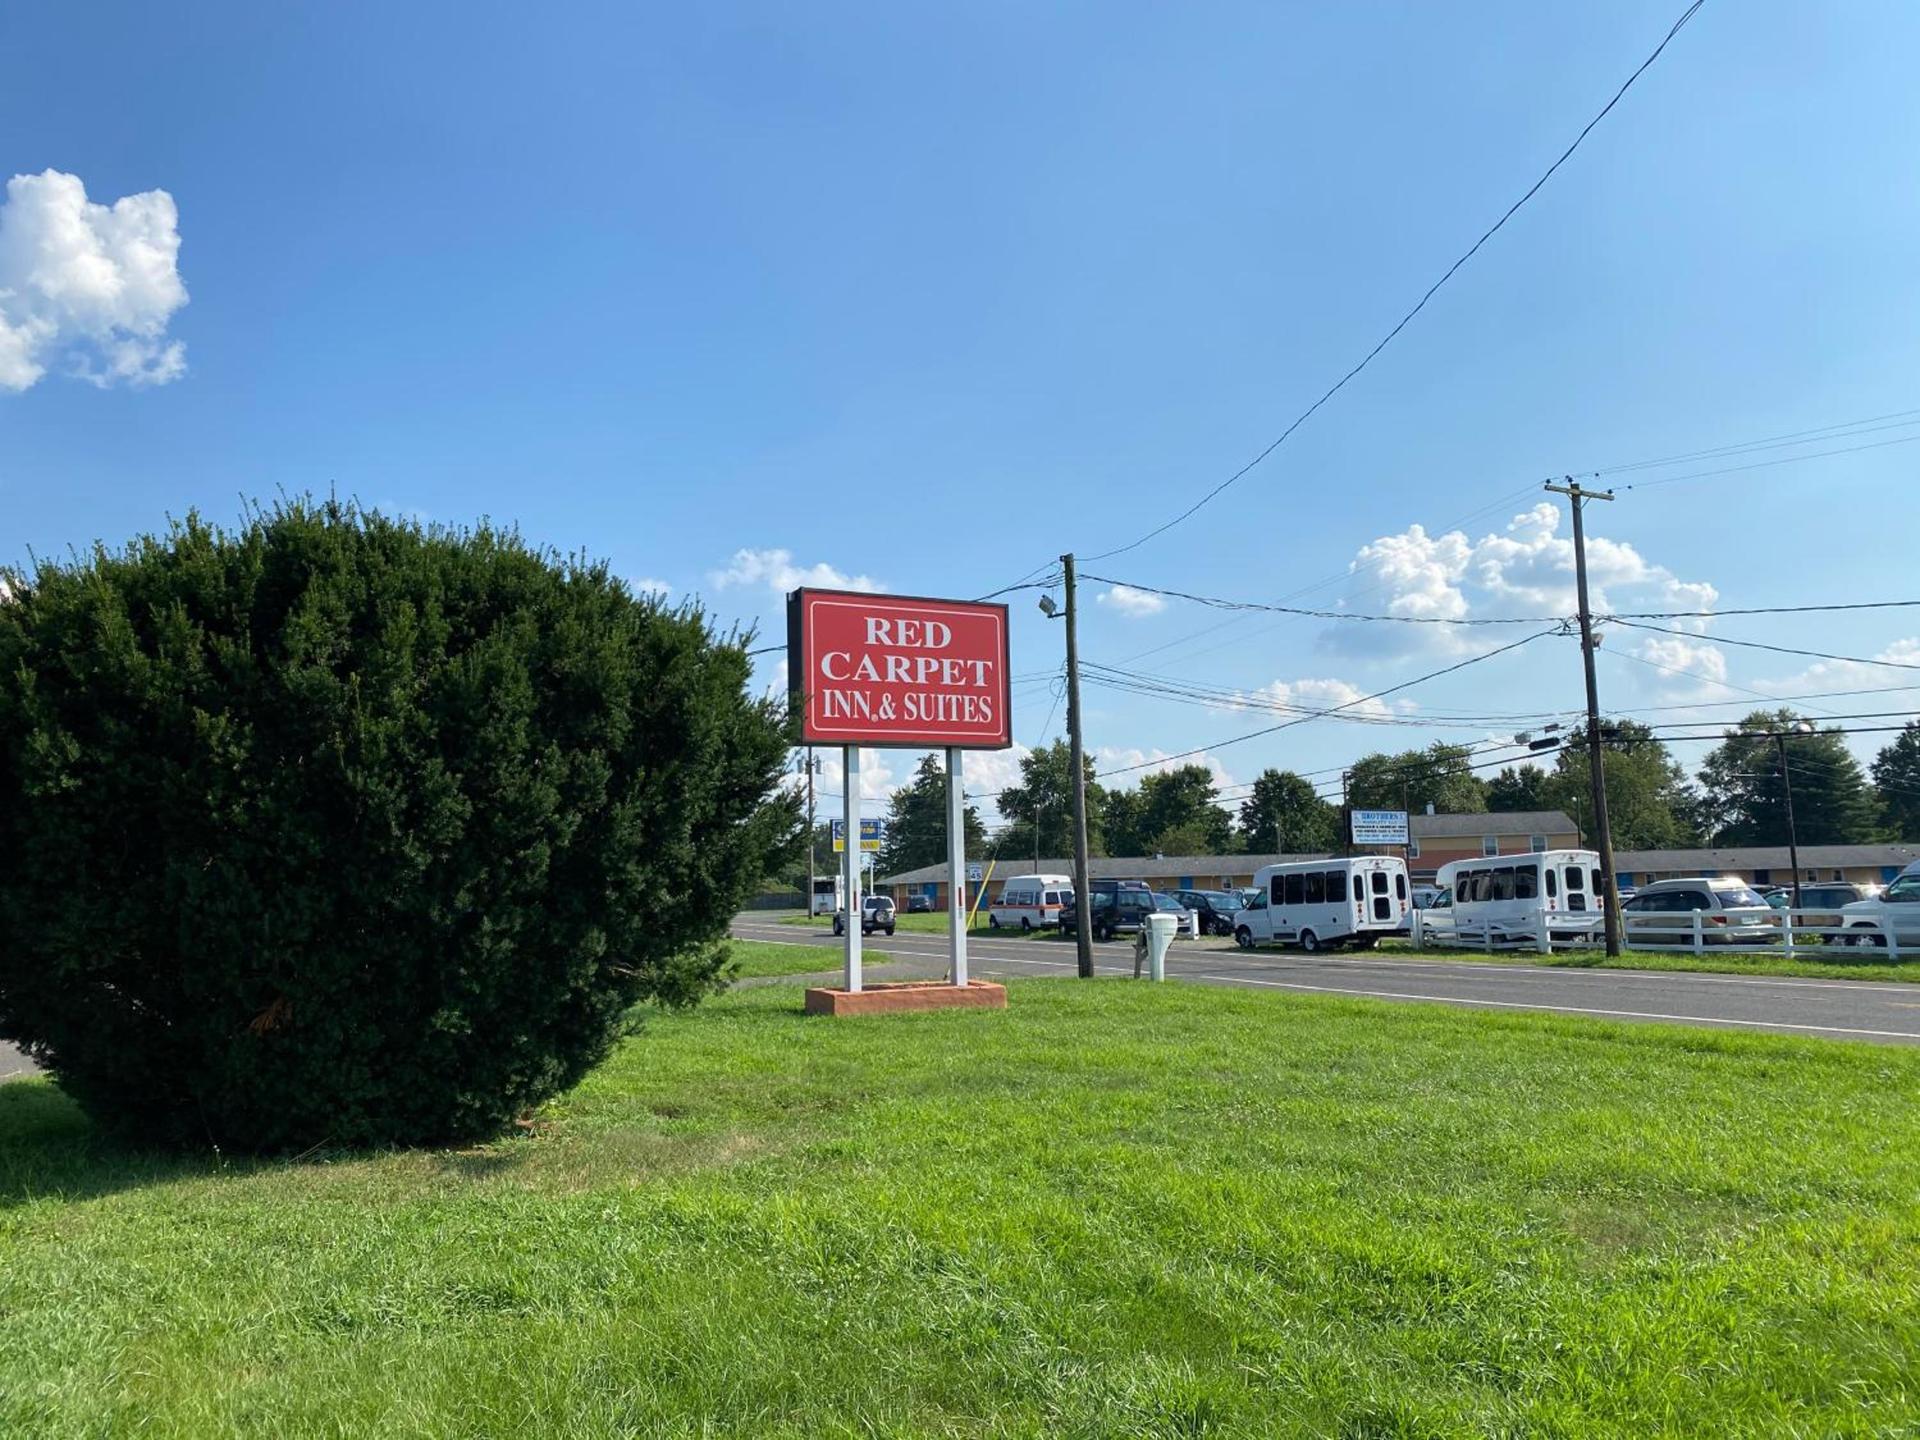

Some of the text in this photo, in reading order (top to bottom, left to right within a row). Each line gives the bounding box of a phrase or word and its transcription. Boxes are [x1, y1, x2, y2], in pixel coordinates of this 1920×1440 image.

[864, 616, 952, 649] RED
[821, 651, 993, 687] CARPET
[822, 689, 993, 723] INN & SUITES
[970, 872, 982, 880] 45
